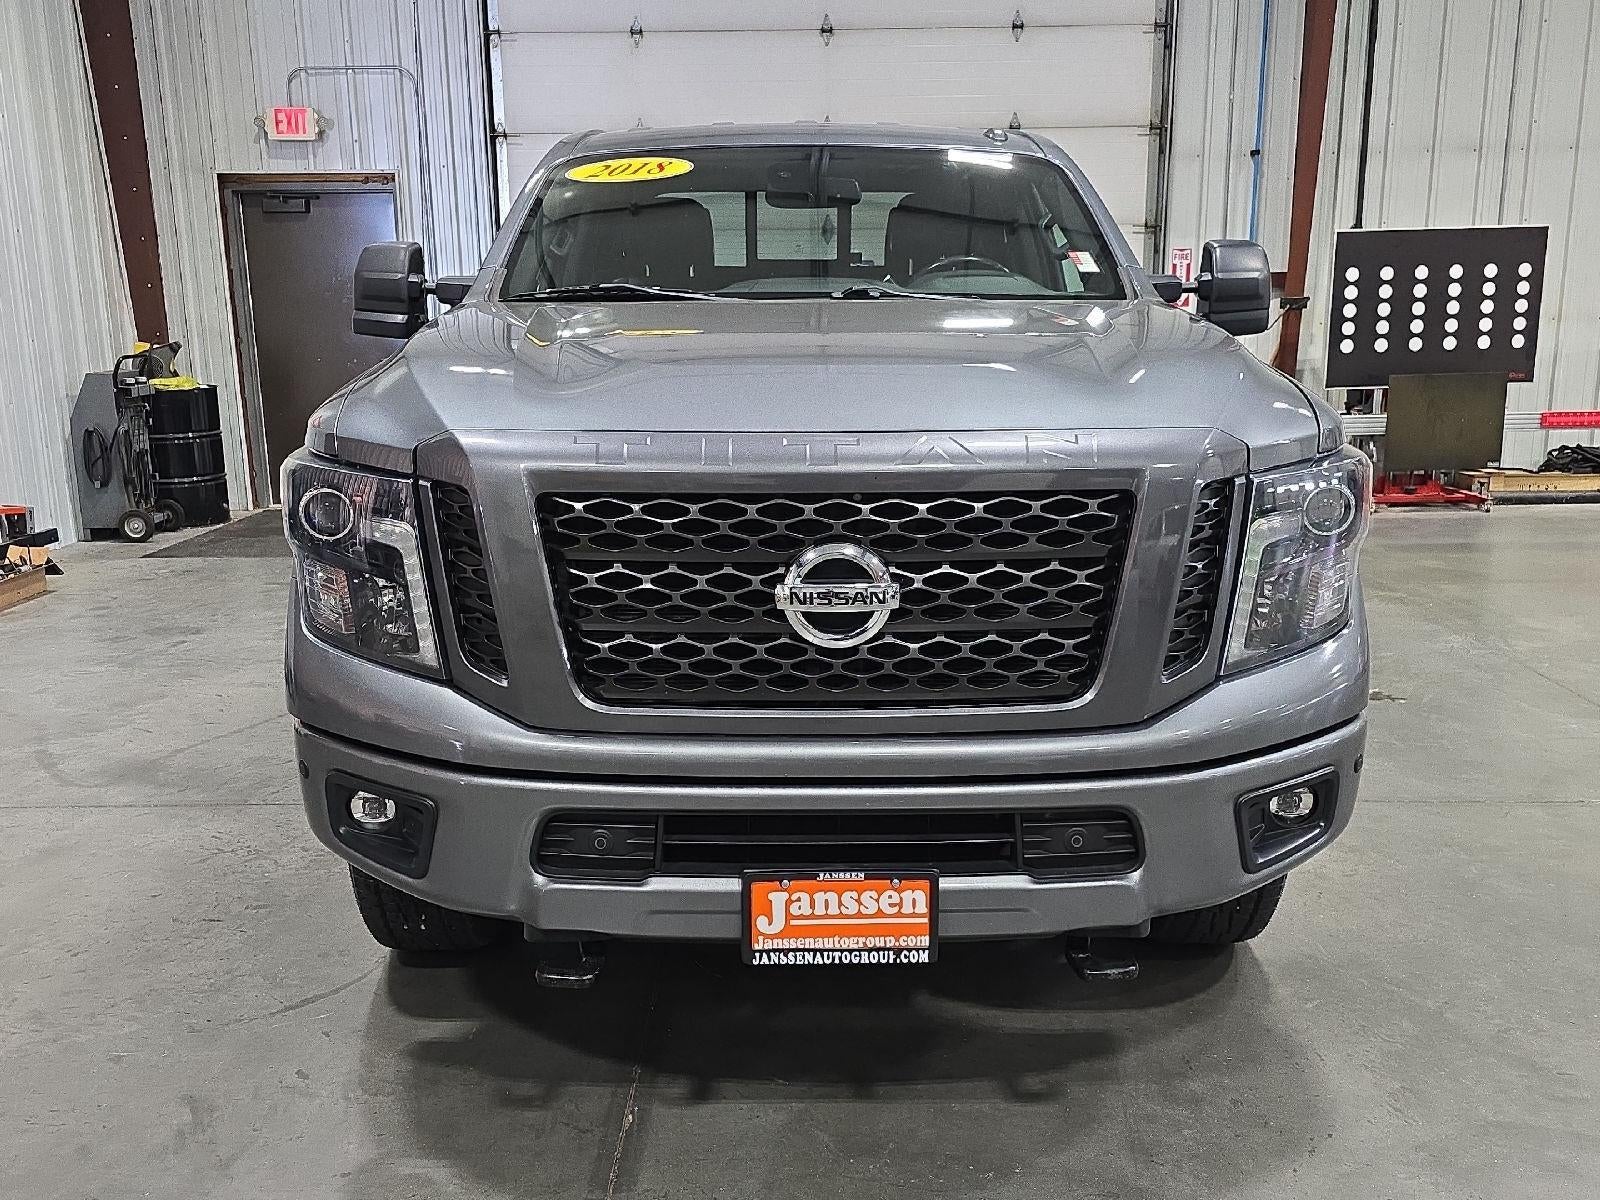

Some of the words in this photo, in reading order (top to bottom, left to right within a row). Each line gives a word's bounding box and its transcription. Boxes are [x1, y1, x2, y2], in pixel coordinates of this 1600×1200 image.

[274, 108, 307, 135] EXIT
[585, 162, 673, 179] 2018
[1173, 252, 1190, 261] FIRE
[573, 433, 1098, 467] TITAN
[789, 591, 887, 606] NISSAN
[817, 872, 864, 880] JANSSEN
[756, 889, 928, 935] Janssen
[754, 935, 929, 949] Janssenautogroup.com
